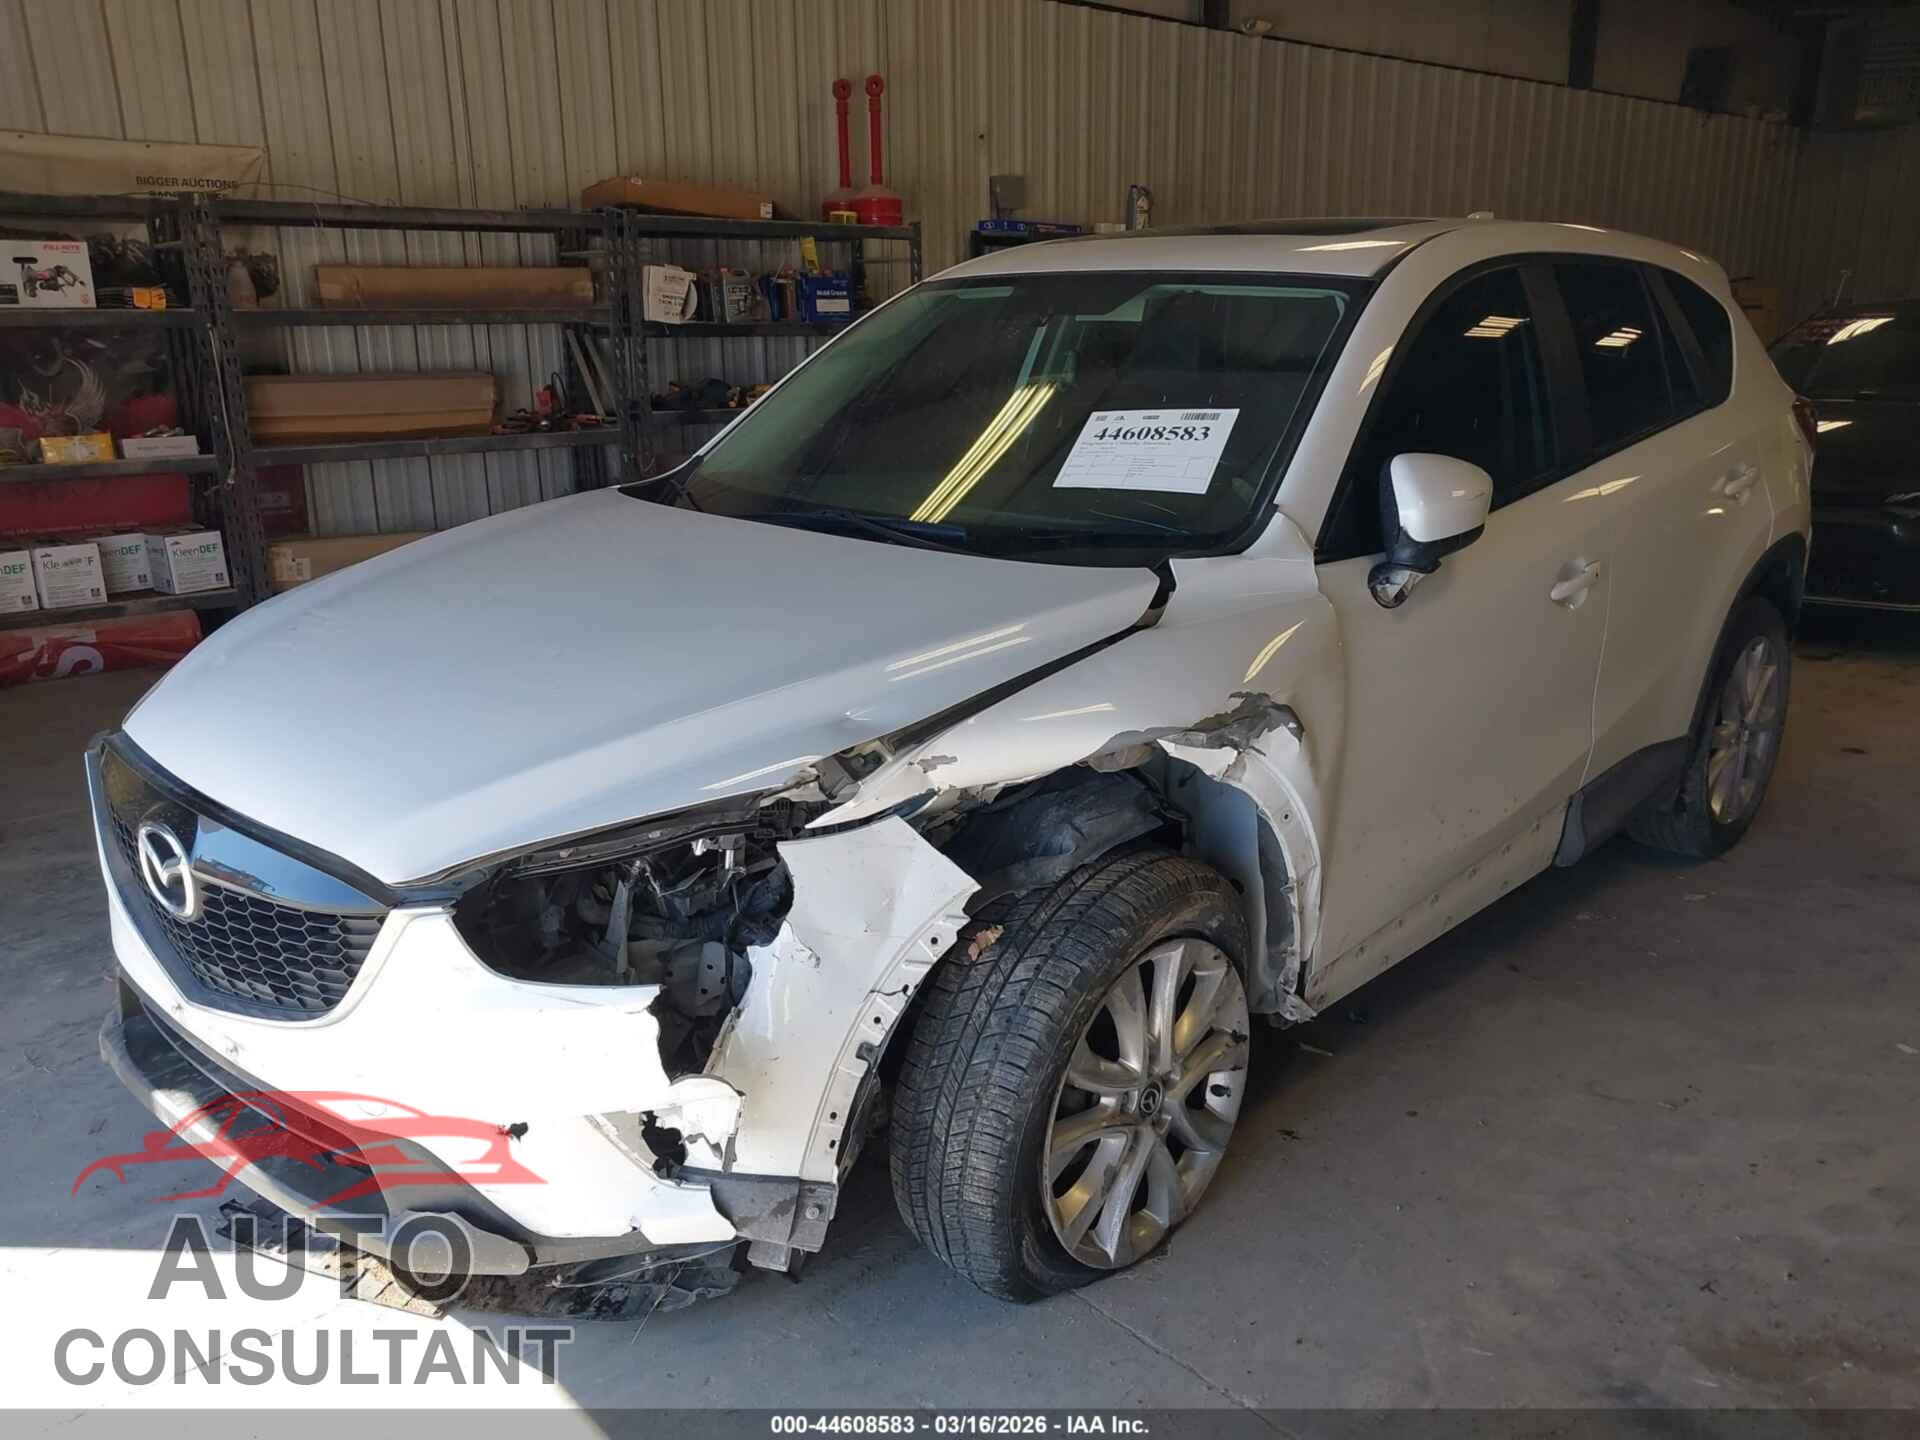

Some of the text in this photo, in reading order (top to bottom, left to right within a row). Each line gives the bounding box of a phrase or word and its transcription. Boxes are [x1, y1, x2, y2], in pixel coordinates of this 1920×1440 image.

[136, 175, 238, 190] BIGGER AUCTIONS
[1093, 426, 1211, 441] 44608583
[172, 542, 219, 560] KleenDEF
